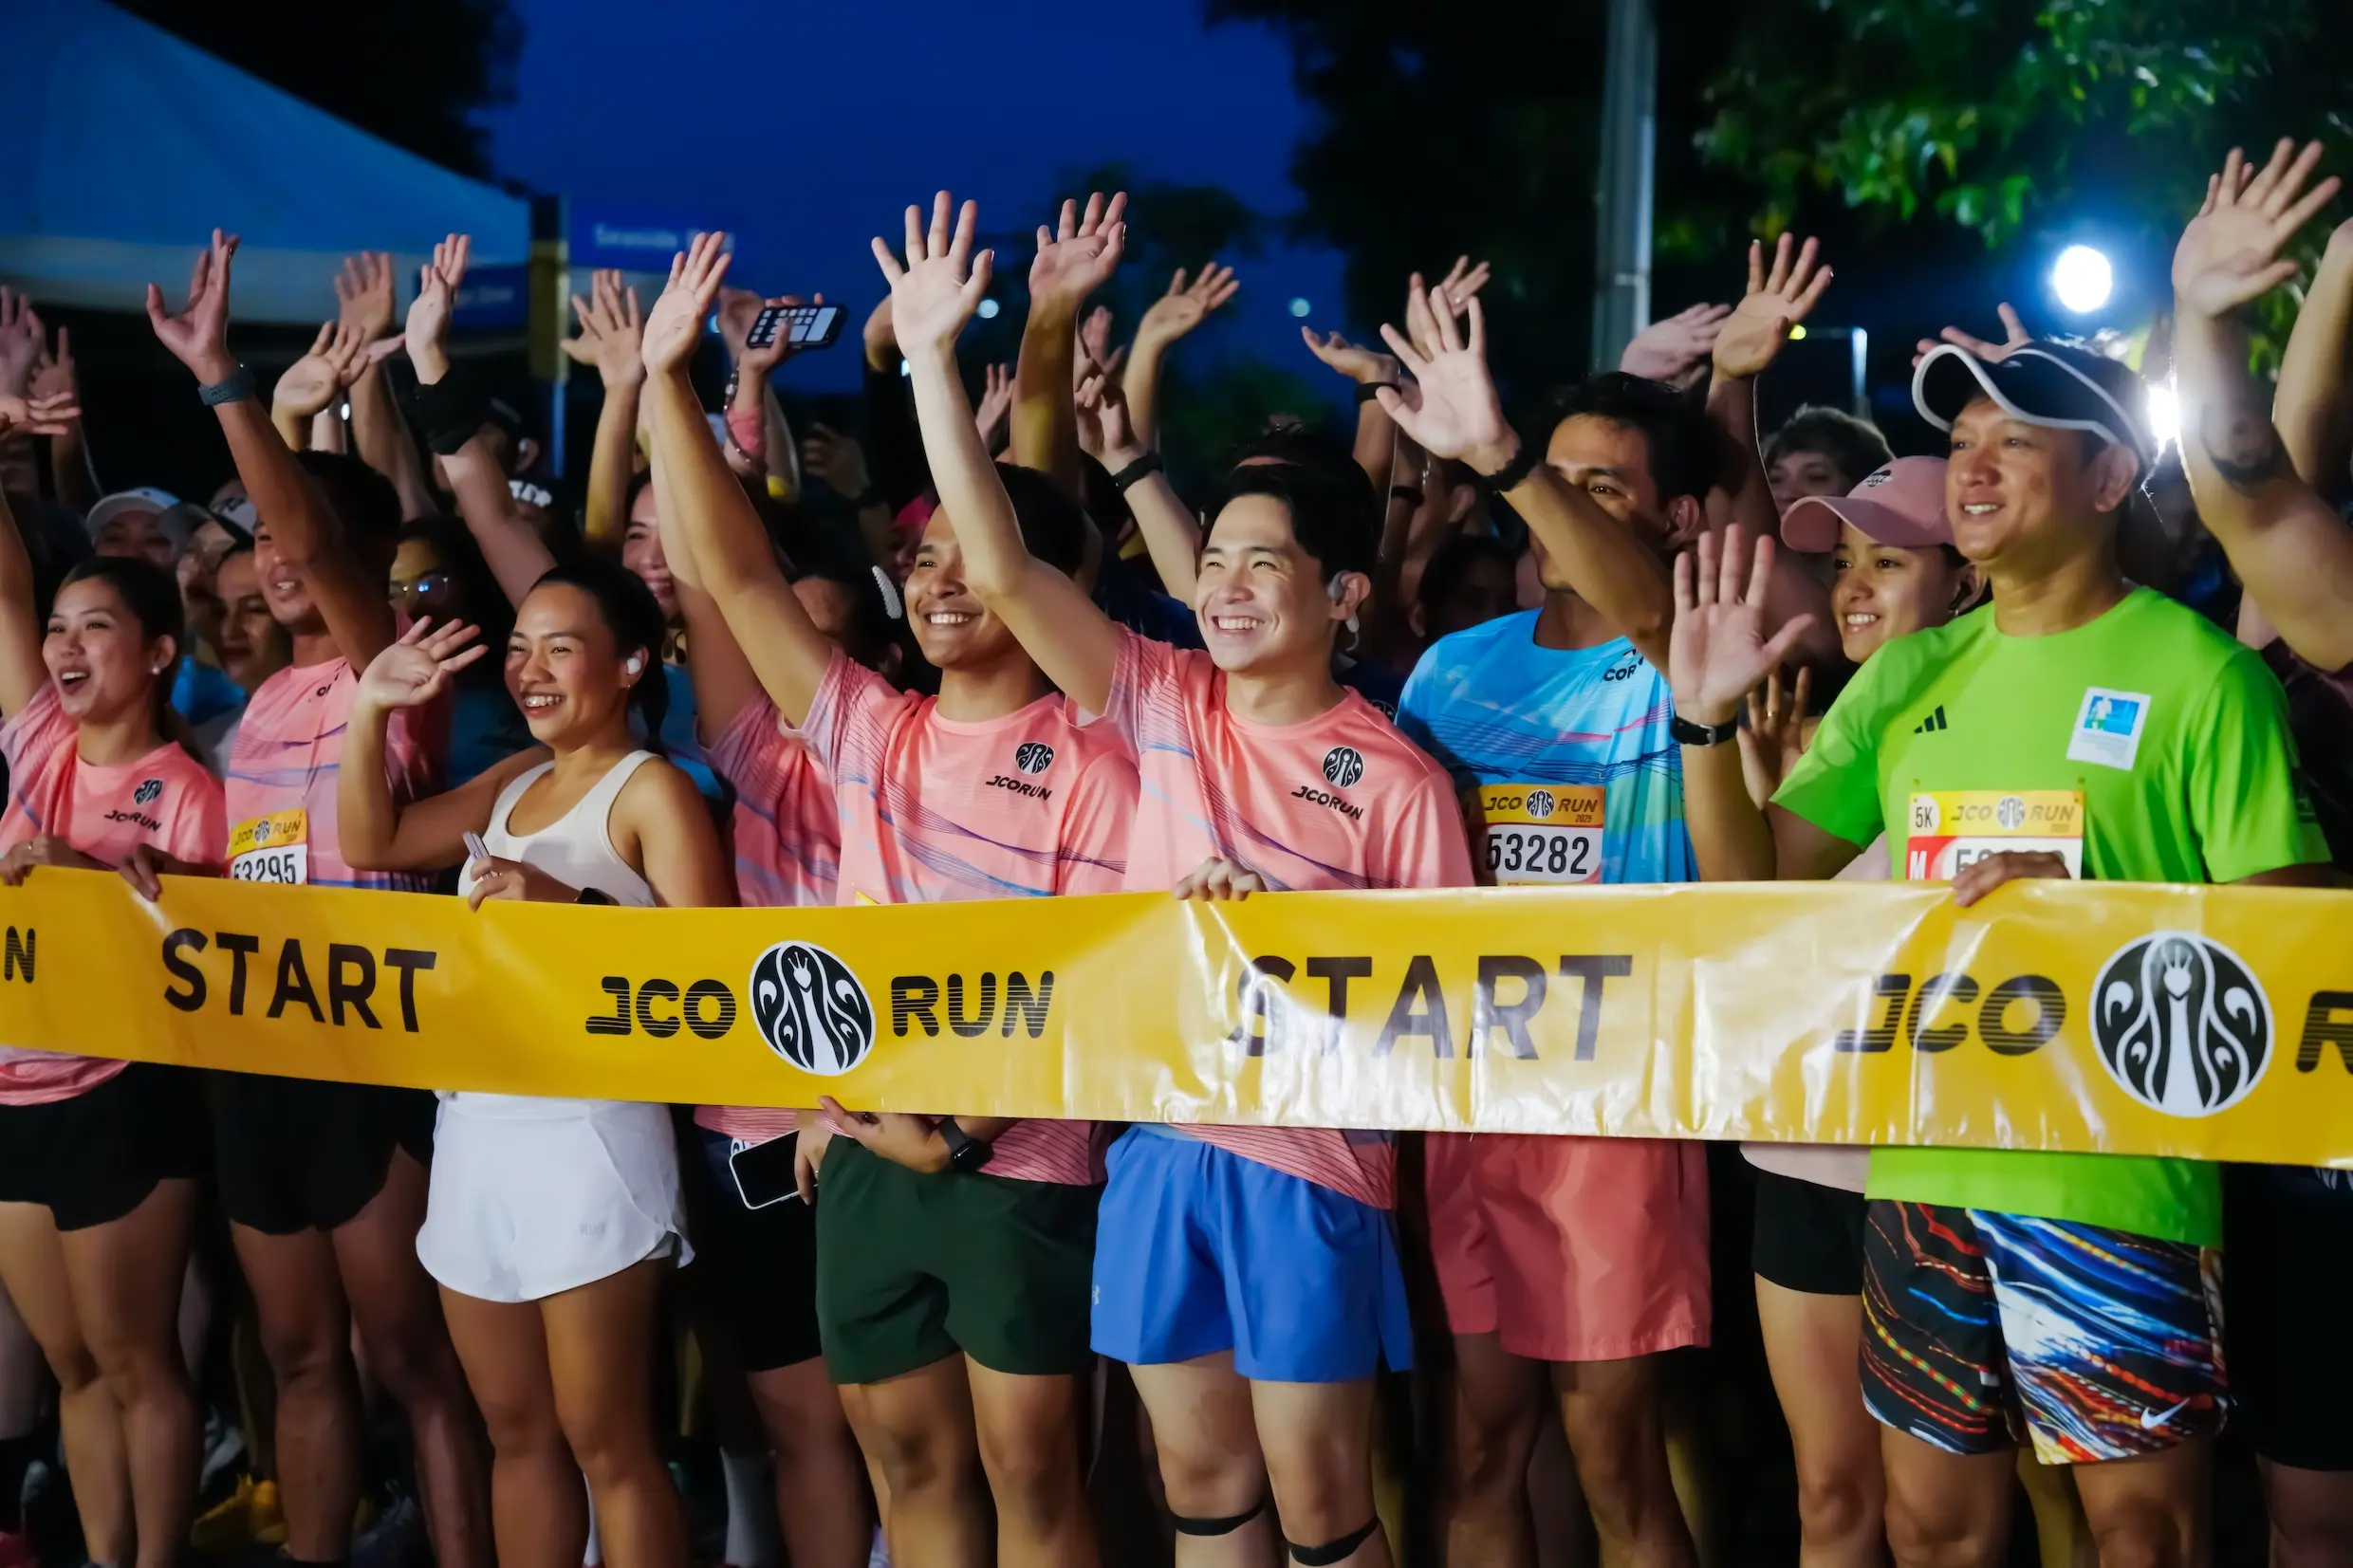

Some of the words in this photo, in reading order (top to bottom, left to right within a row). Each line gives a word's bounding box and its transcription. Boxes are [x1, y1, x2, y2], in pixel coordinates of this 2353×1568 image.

[985, 775, 1052, 801] JCORUN
[1290, 785, 1364, 821] JCORUN
[1484, 796, 1523, 811] JCO
[1557, 798, 1598, 813] RUN
[1915, 805, 1933, 828] 5K
[1950, 805, 1992, 821] JCO
[2030, 804, 2075, 822] RUN
[1485, 833, 1589, 875] 53282
[161, 927, 437, 1033] START
[584, 975, 737, 1040] JCO
[890, 970, 1055, 1040] RUN
[1227, 954, 1633, 1061] START
[1834, 973, 2066, 1057] JCO
